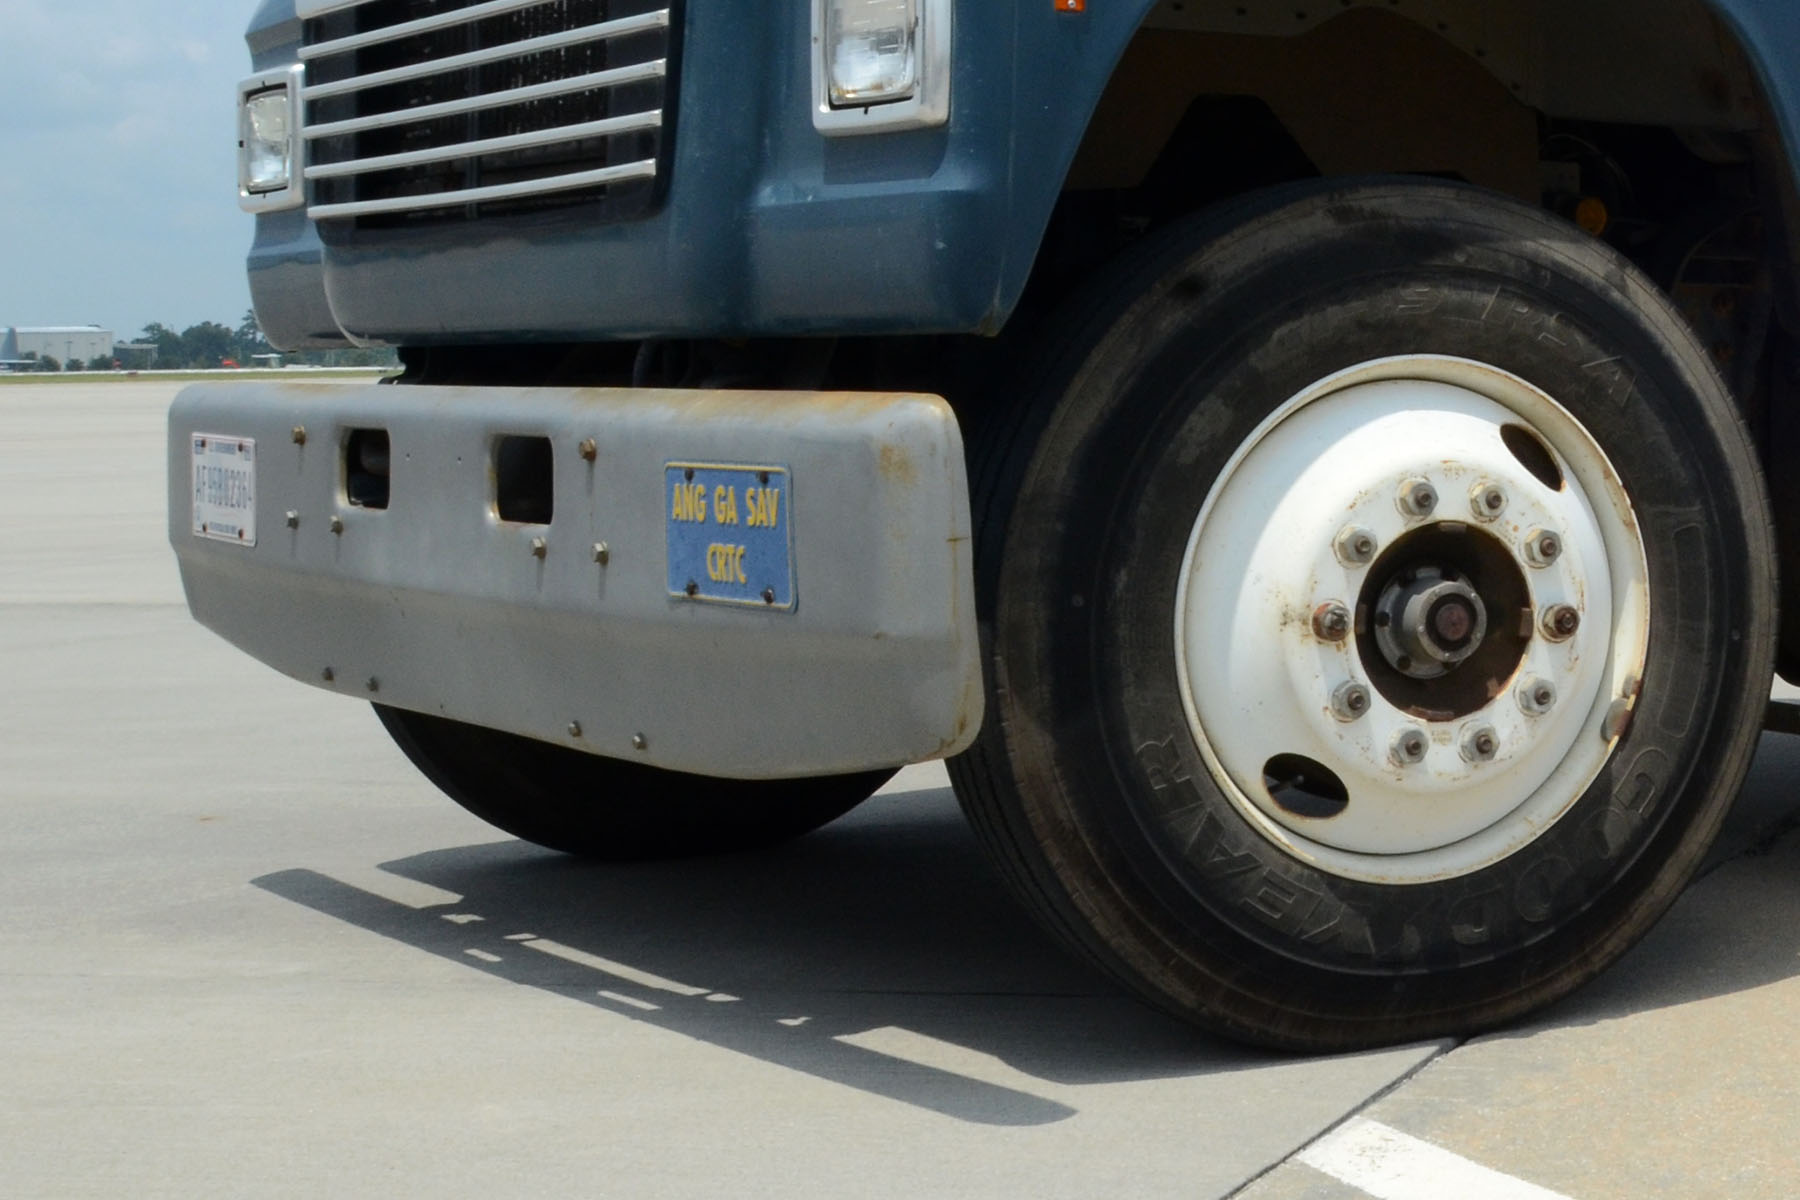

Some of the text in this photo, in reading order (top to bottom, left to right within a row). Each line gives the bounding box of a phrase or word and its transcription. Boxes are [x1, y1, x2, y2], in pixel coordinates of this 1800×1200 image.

[671, 483, 781, 529] ANG GA SAV
[705, 541, 748, 585] CRTC
